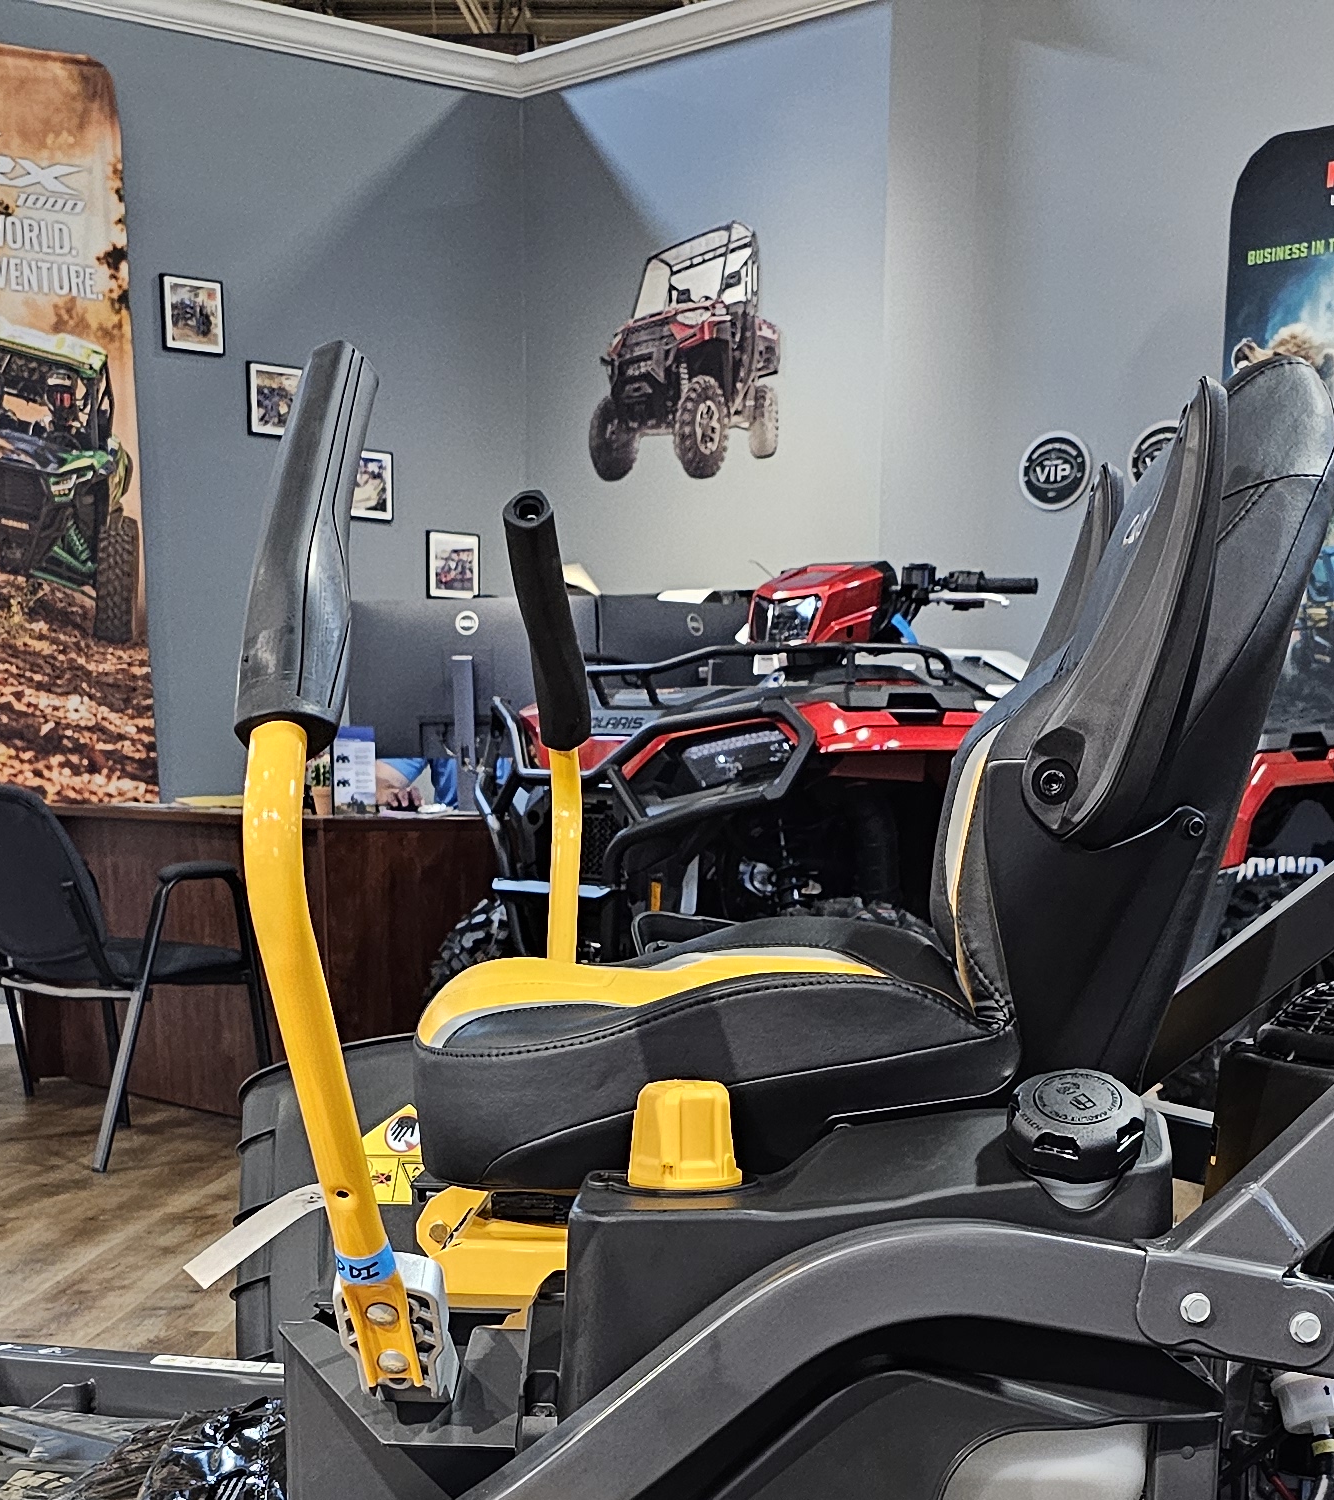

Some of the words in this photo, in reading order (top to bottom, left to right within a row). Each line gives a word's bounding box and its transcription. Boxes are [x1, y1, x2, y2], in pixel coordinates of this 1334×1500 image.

[16, 192, 86, 215] 1000
[1246, 241, 1309, 267] BUSINESS
[1311, 240, 1326, 256] IN
[1035, 463, 1072, 484] VIP
[591, 716, 646, 730] OLARIS
